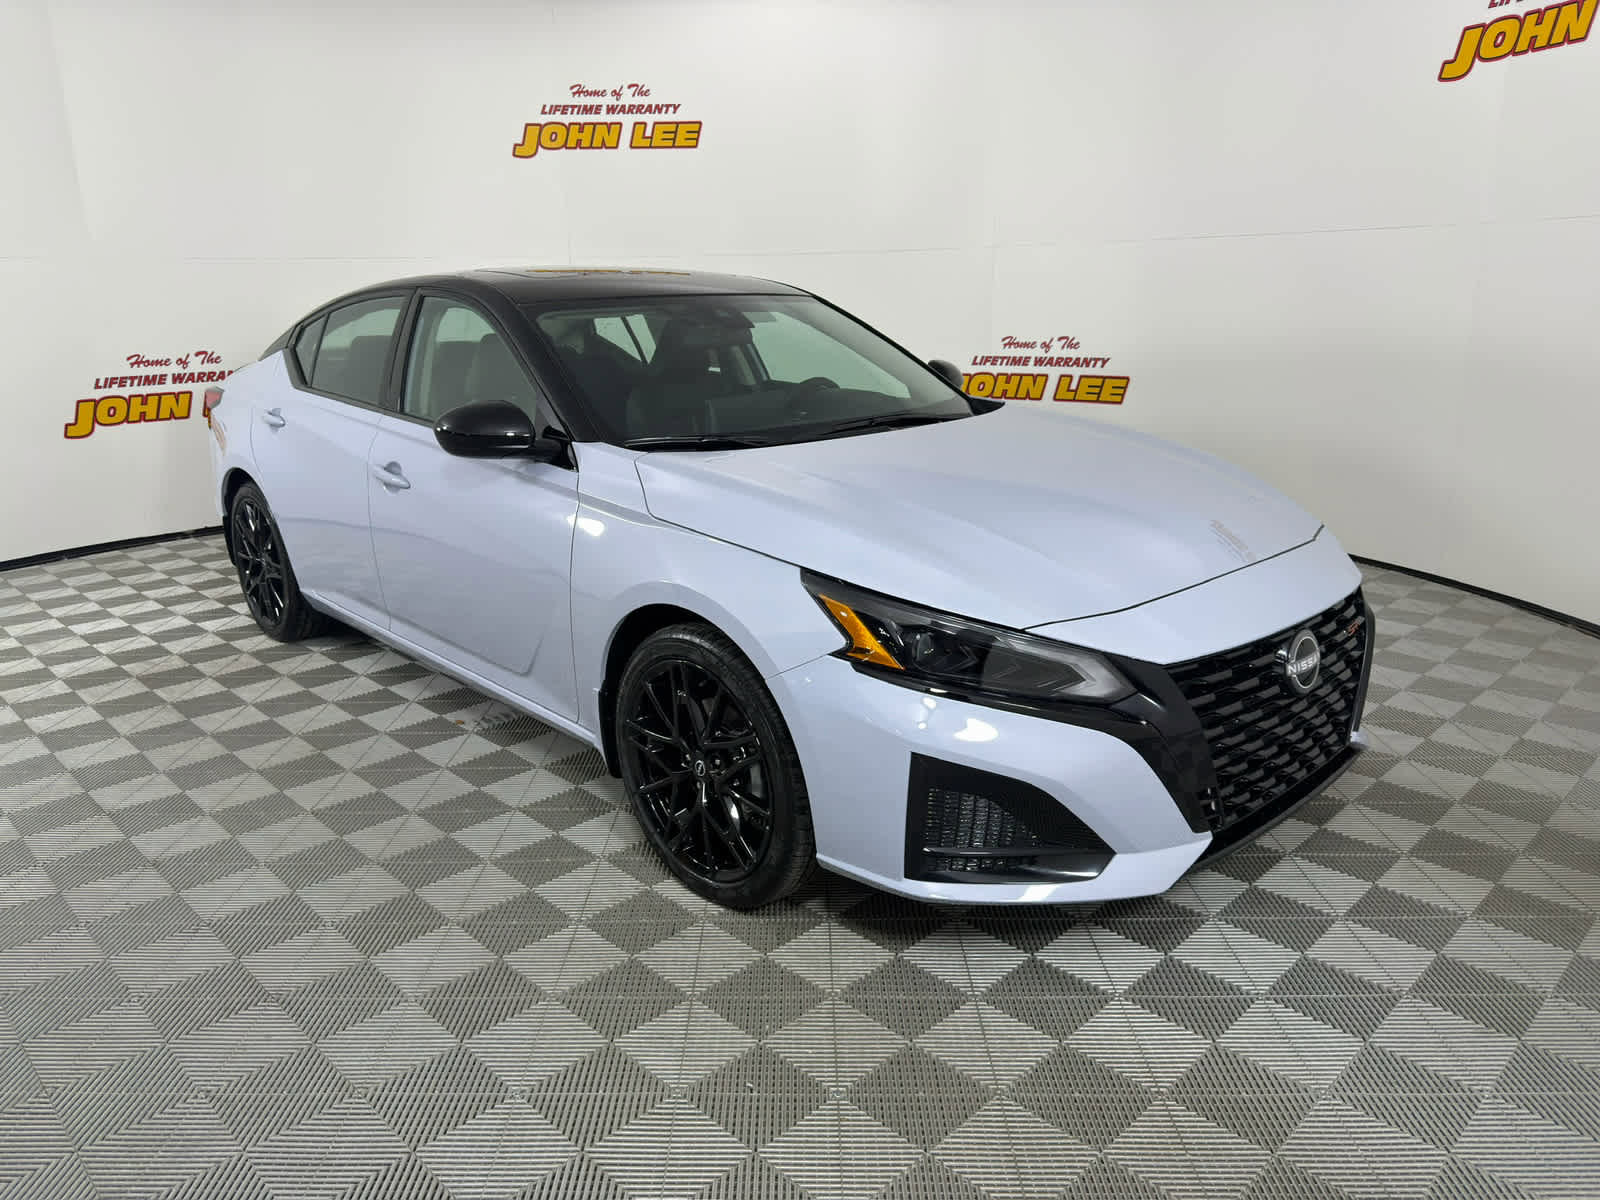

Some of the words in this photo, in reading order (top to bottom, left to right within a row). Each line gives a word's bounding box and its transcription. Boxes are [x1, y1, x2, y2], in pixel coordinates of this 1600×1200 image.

[1437, 0, 1600, 82] JOHN
[569, 83, 608, 98] Home
[610, 85, 624, 101] of
[627, 83, 651, 98] The
[540, 104, 603, 115] LIFETIME
[605, 103, 682, 115] WARRANTY
[512, 121, 623, 159] JOHN
[629, 120, 703, 149] LEE
[1001, 335, 1038, 350] Home
[1040, 336, 1054, 353] of
[1057, 335, 1081, 350] The
[126, 353, 172, 368] Home
[175, 353, 191, 370] of
[194, 350, 222, 365] The
[971, 355, 1032, 367] LIFETIME
[1033, 356, 1111, 369] WARRANTY
[94, 373, 168, 390] LIFETIME
[1053, 374, 1131, 405] LEE
[64, 390, 193, 439] JOHN
